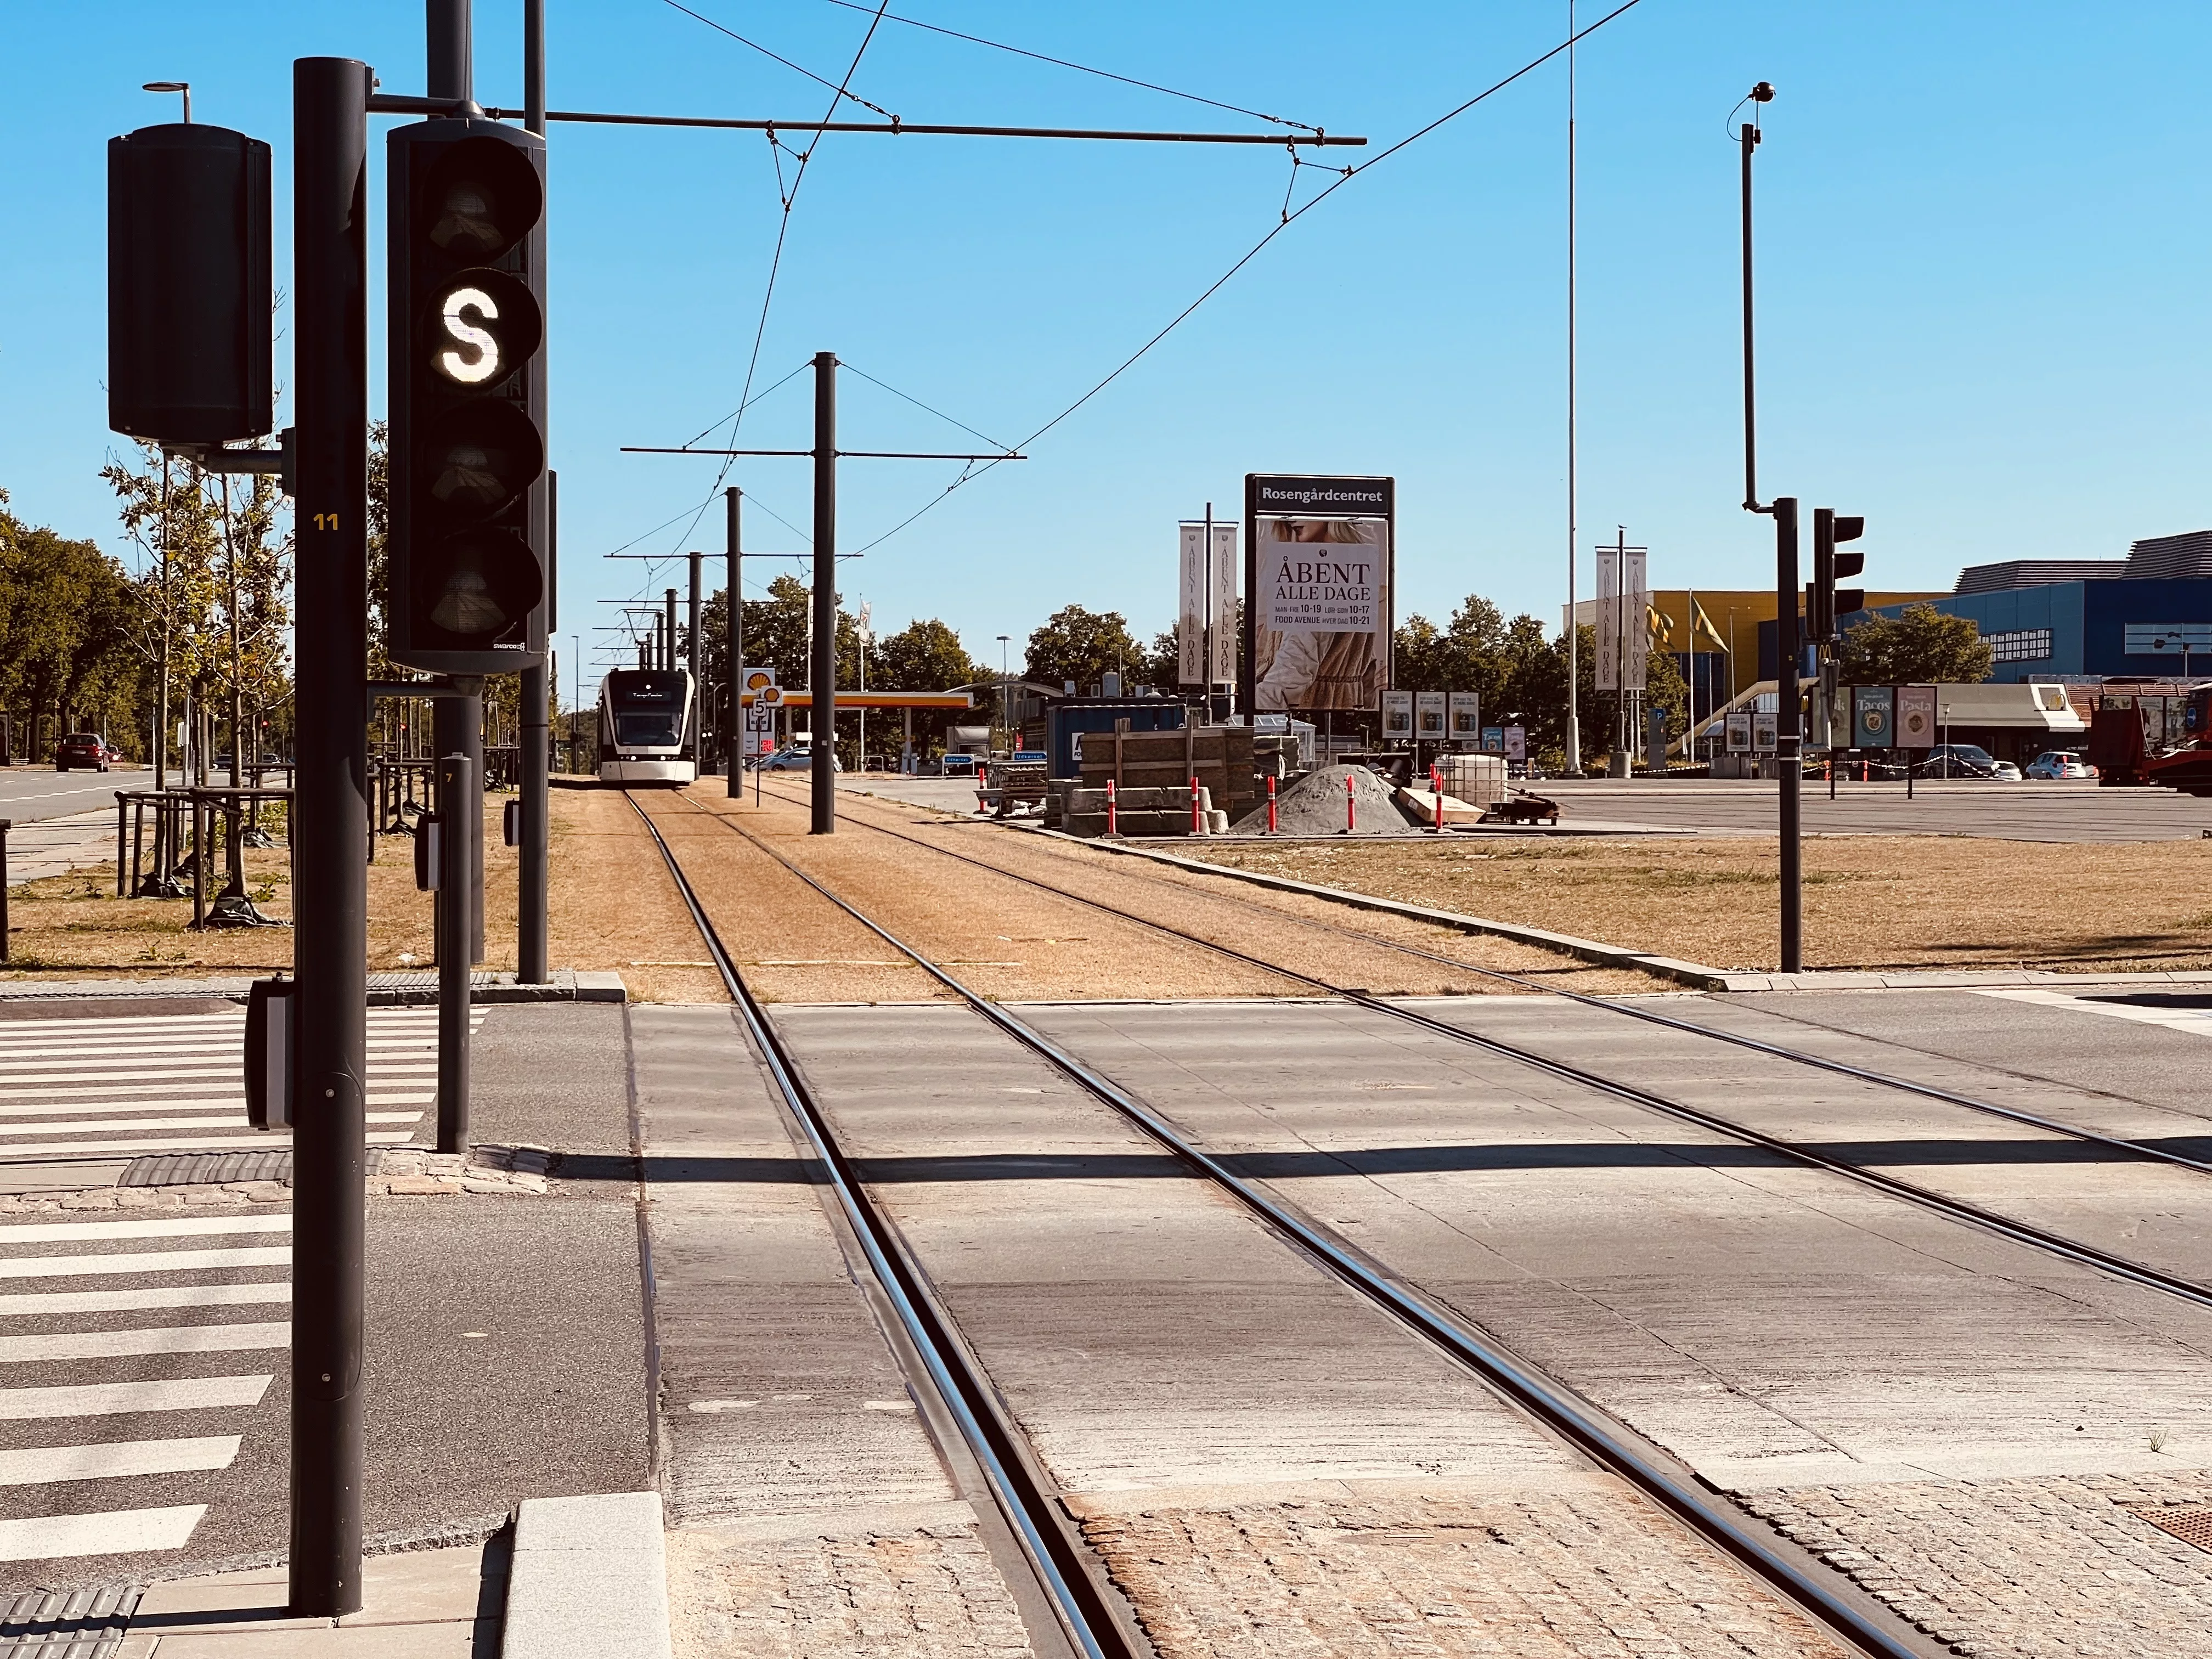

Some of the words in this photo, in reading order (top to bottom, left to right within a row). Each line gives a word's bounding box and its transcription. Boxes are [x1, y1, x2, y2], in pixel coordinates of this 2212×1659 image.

[442, 288, 498, 382] S
[1262, 487, 1383, 504] Rosengårdcentret
[313, 514, 338, 531] 11
[1276, 556, 1370, 584] ÅBENT
[1276, 585, 1319, 600] ALLE
[1324, 586, 1370, 601] DAGE
[1301, 605, 1321, 613] 10-19
[1350, 616, 1370, 624] 10-21
[1187, 640, 1195, 676] DAGE
[1221, 640, 1229, 676] DAGE
[755, 701, 765, 714] 5
[1857, 699, 1891, 711] Tacos
[1900, 699, 1932, 712] Pasta
[446, 773, 452, 782] 7
